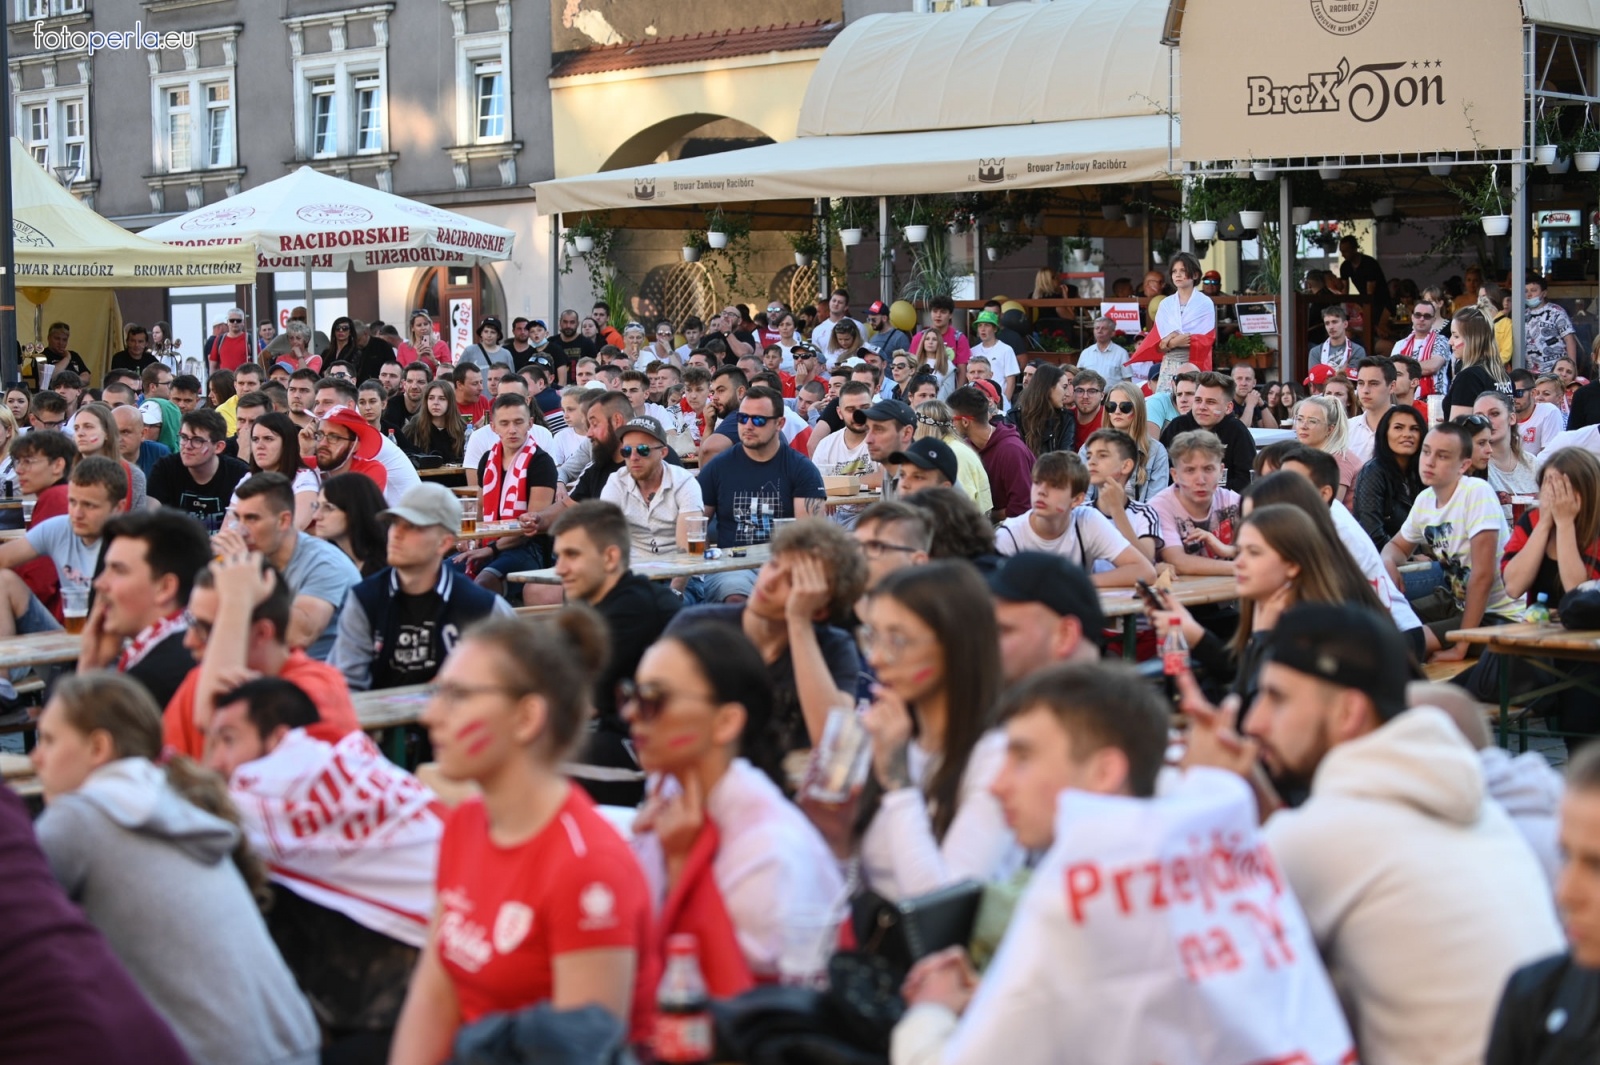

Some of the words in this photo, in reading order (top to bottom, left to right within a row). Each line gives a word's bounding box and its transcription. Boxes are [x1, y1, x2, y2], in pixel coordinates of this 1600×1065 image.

[1329, 3, 1359, 13] RACIBÓRZ
[1027, 162, 1053, 173] Browar
[1055, 160, 1090, 172] Zamkowy
[1092, 158, 1127, 170] Racibórz
[673, 181, 696, 191] Browar
[696, 179, 725, 190] Zamkowy
[726, 178, 754, 188] Racibórz
[279, 226, 410, 252] RACIBORSKIE
[436, 227, 506, 253] RACIBORSKIE
[53, 262, 114, 277] RACIBÓRZ
[134, 264, 183, 276] BROWAR
[186, 260, 242, 275] RACIBÓRZ
[460, 302, 471, 326] 432
